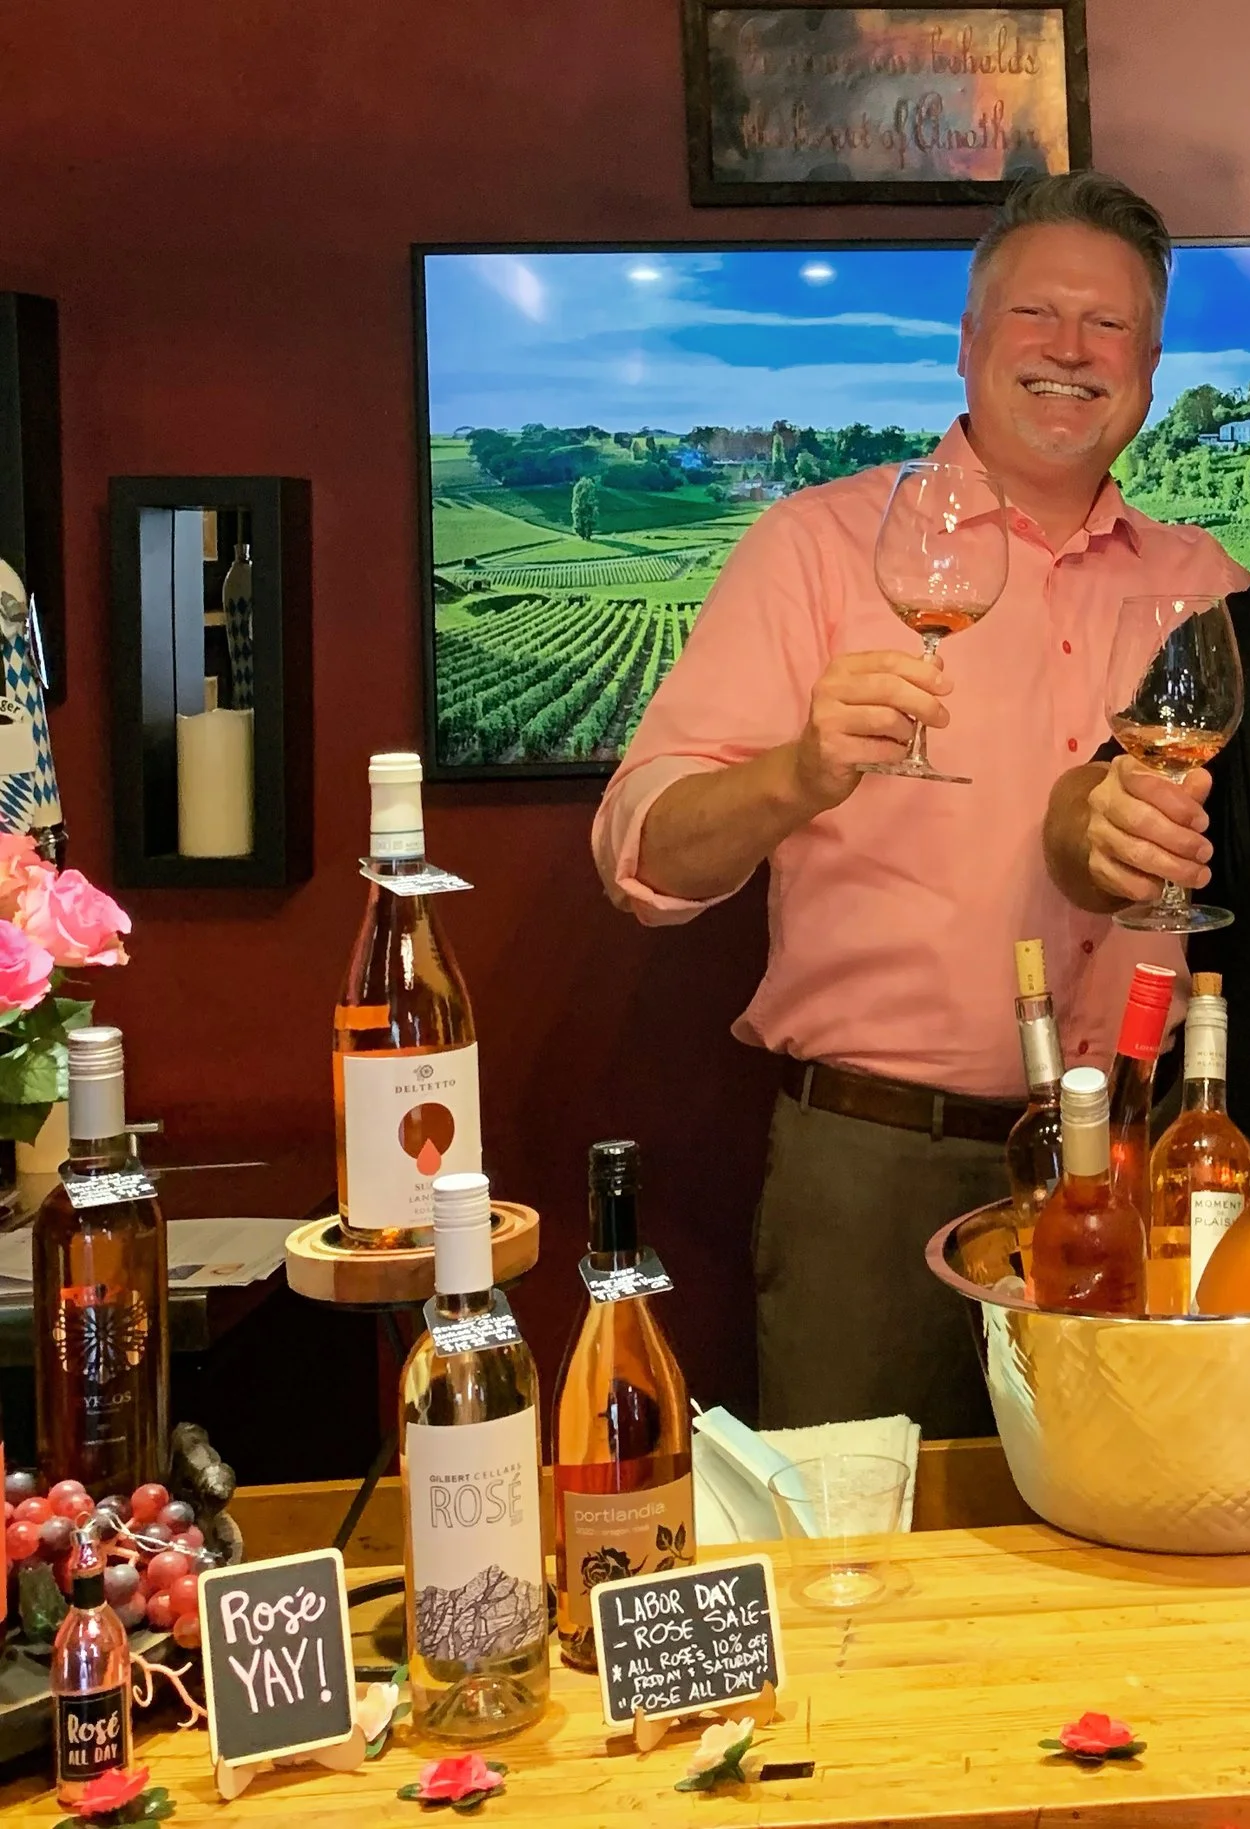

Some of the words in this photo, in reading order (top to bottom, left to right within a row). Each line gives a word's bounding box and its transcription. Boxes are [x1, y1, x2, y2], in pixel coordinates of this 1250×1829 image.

[395, 1079, 456, 1094] DELTETTO
[1194, 1199, 1242, 1209] MOMENT
[1194, 1217, 1232, 1227] PLAIS
[429, 1474, 470, 1483] GILBERT
[473, 1462, 522, 1481] CELLARS
[430, 1472, 522, 1528] ROSÉ
[574, 1502, 665, 1524] portlandia
[220, 1586, 326, 1645] Rosé
[615, 1589, 685, 1626] LABOR
[694, 1576, 739, 1610] DAY
[634, 1619, 694, 1650] ROSE
[628, 1657, 653, 1678] ALL
[713, 1633, 742, 1657] 10%
[748, 1633, 768, 1649] OFF
[633, 1667, 681, 1694] FRIDAY
[702, 1645, 769, 1675] SATURDAY
[228, 1637, 332, 1713] YAY!
[689, 1680, 716, 1700] ALL
[67, 1710, 120, 1745] Rosé
[69, 1749, 89, 1766] ALL
[94, 1743, 118, 1763] DAY
